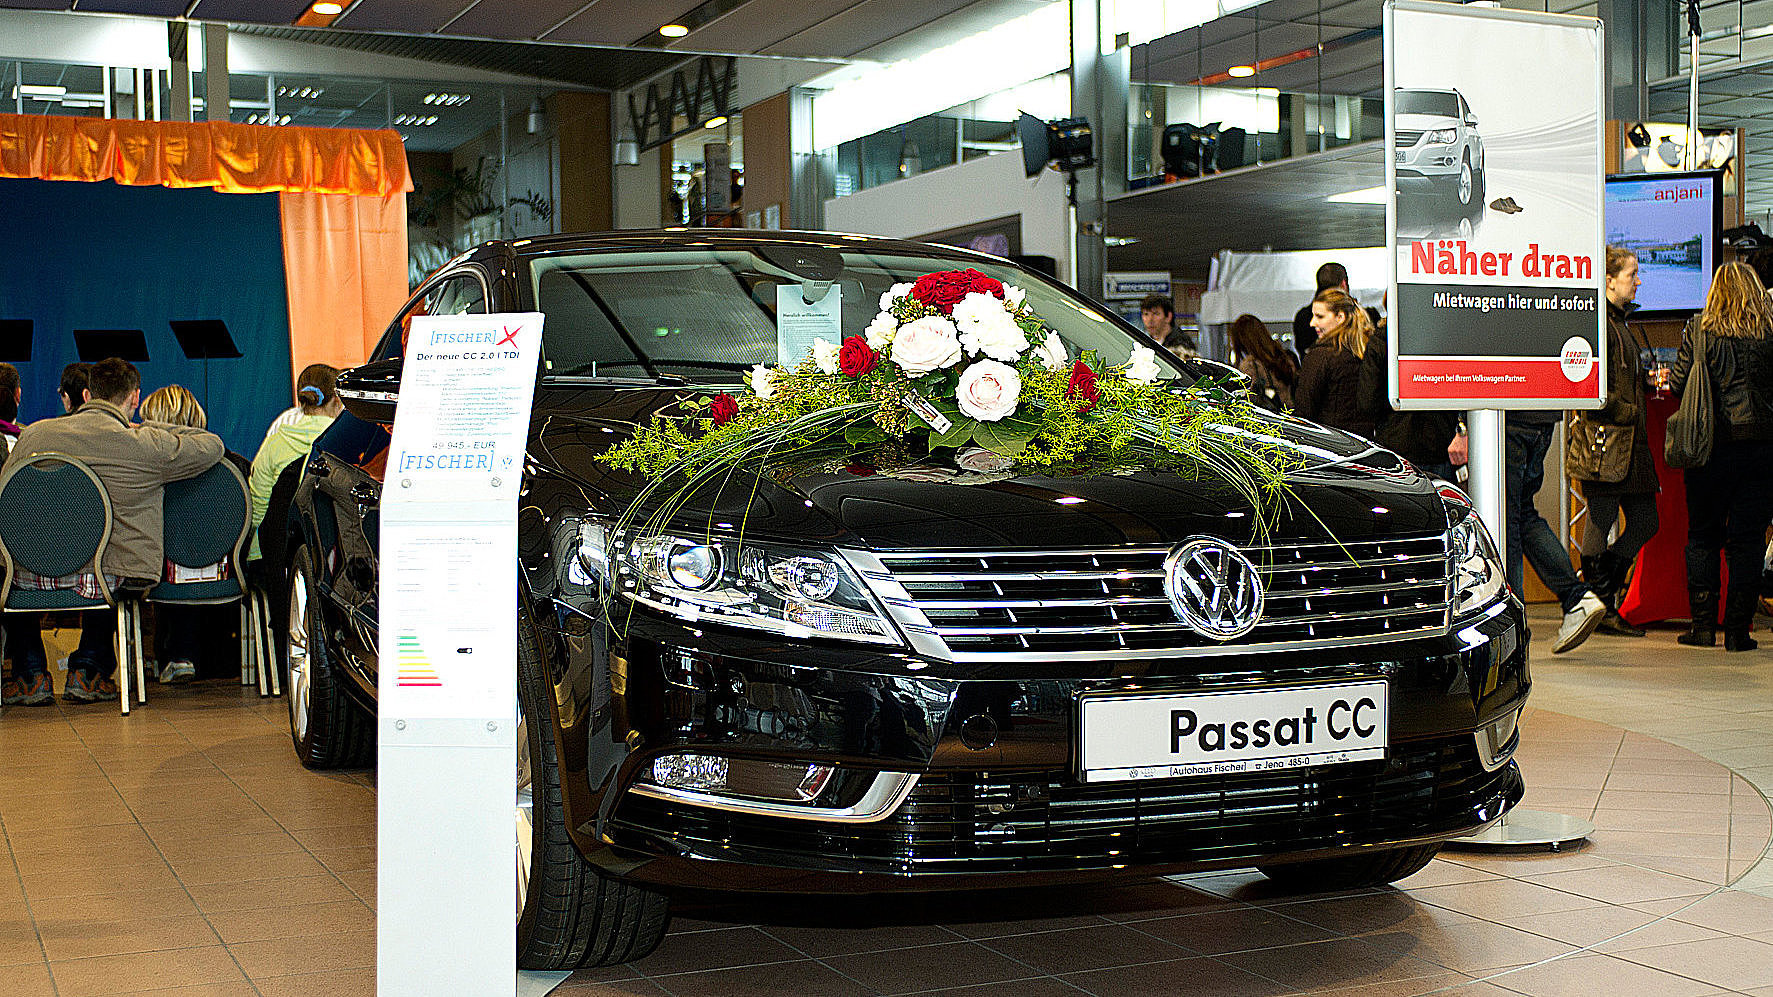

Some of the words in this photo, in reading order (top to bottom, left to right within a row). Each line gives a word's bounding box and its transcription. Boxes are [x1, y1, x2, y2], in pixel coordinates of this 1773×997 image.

[1654, 184, 1703, 203] anjani
[1411, 239, 1513, 277] Näher
[1521, 243, 1592, 279] dran
[1433, 292, 1505, 313] Mietwagen
[1507, 293, 1532, 310] hier
[1534, 294, 1558, 310] und
[1560, 294, 1595, 311] sofort
[416, 352, 433, 361] Der
[436, 353, 460, 361] neue
[463, 352, 477, 360] CC
[480, 352, 495, 360] 2.0
[503, 351, 520, 359] TDI
[1412, 374, 1445, 384] Mietwagen
[1445, 373, 1455, 382] bei
[1472, 374, 1504, 384] Volkswagen
[473, 441, 496, 450] EUR
[1170, 707, 1318, 754] Passat
[1326, 697, 1377, 741] CC
[1264, 760, 1284, 769] Jena
